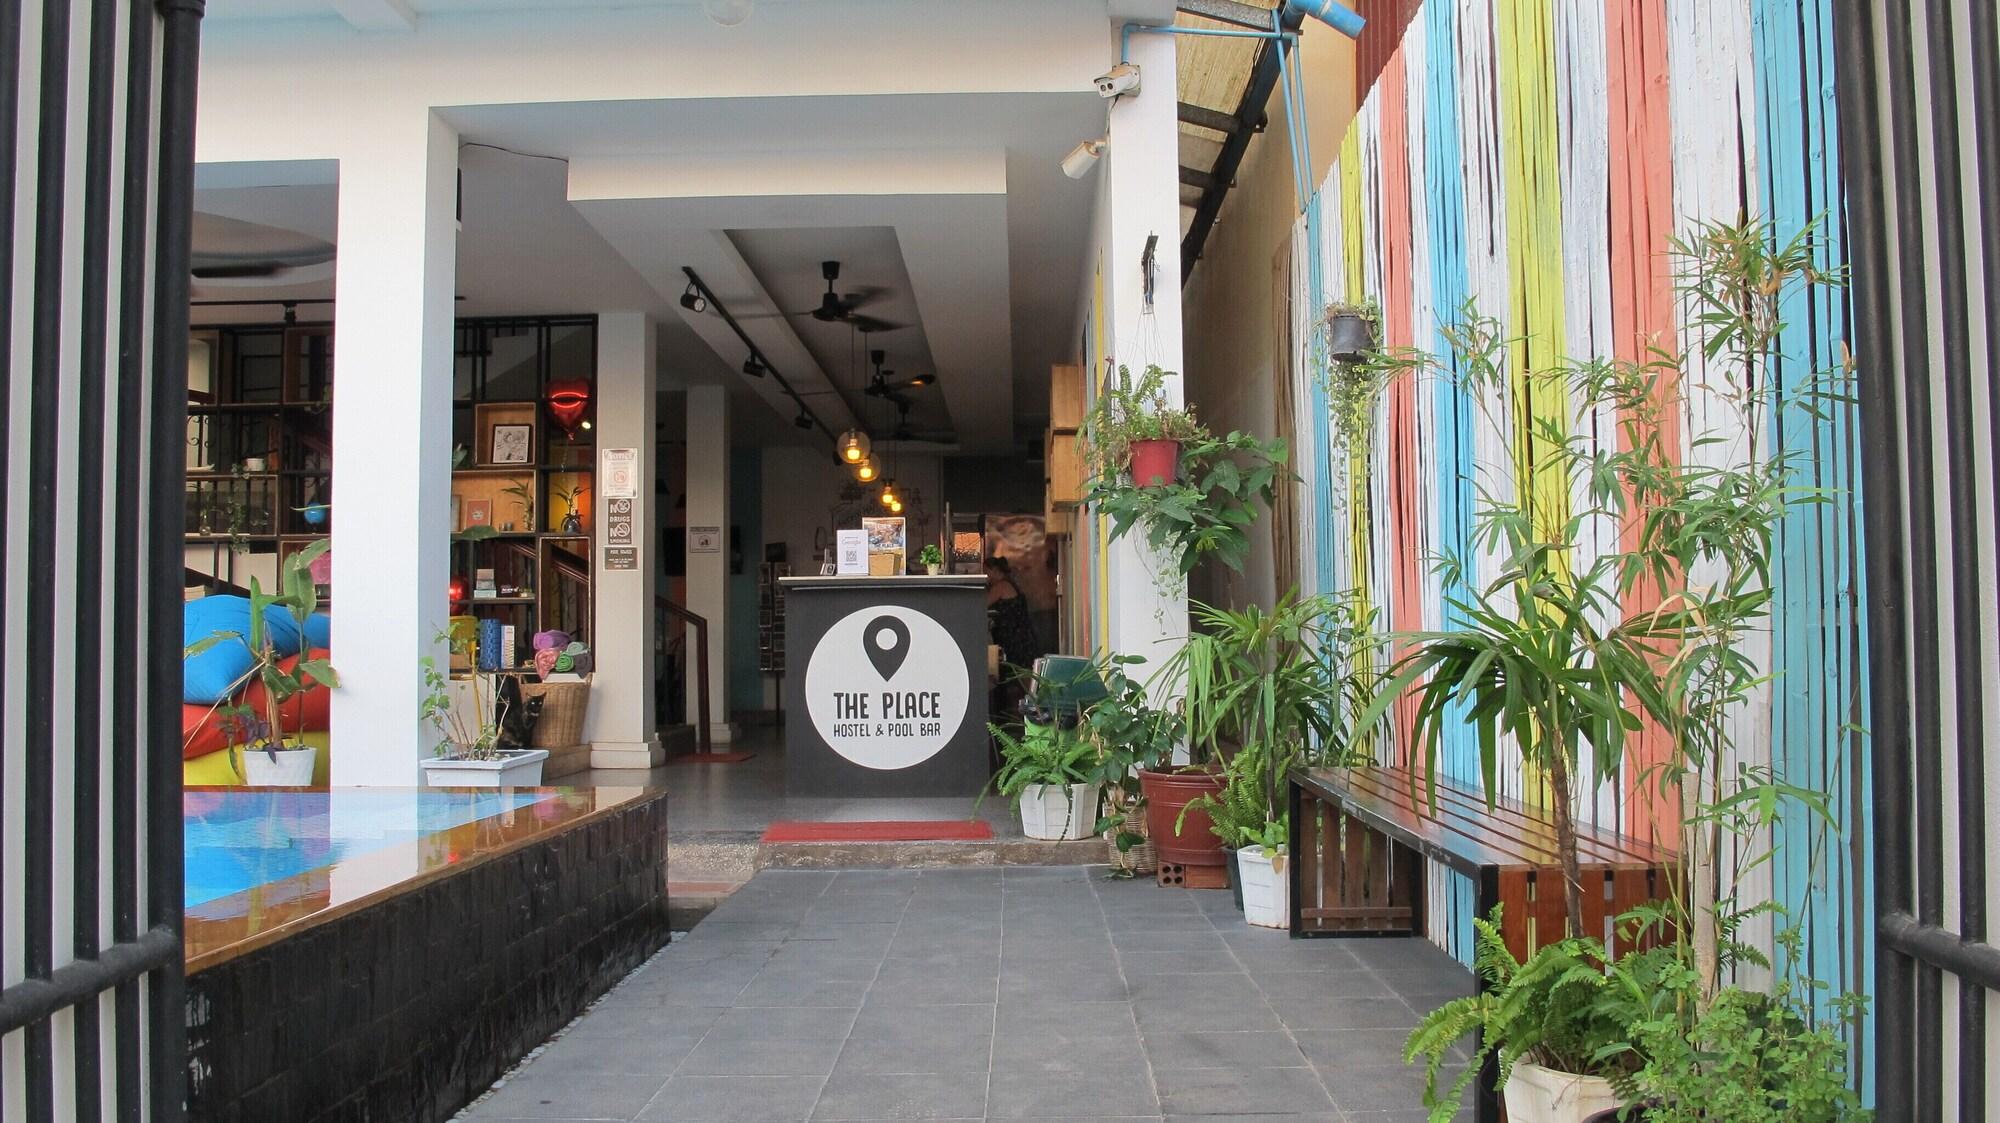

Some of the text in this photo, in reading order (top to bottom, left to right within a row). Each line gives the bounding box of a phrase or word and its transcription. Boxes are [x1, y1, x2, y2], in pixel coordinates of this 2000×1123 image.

[833, 691, 941, 720] THE PLACE
[833, 722, 941, 737] HOSTEL & POOL BAR
